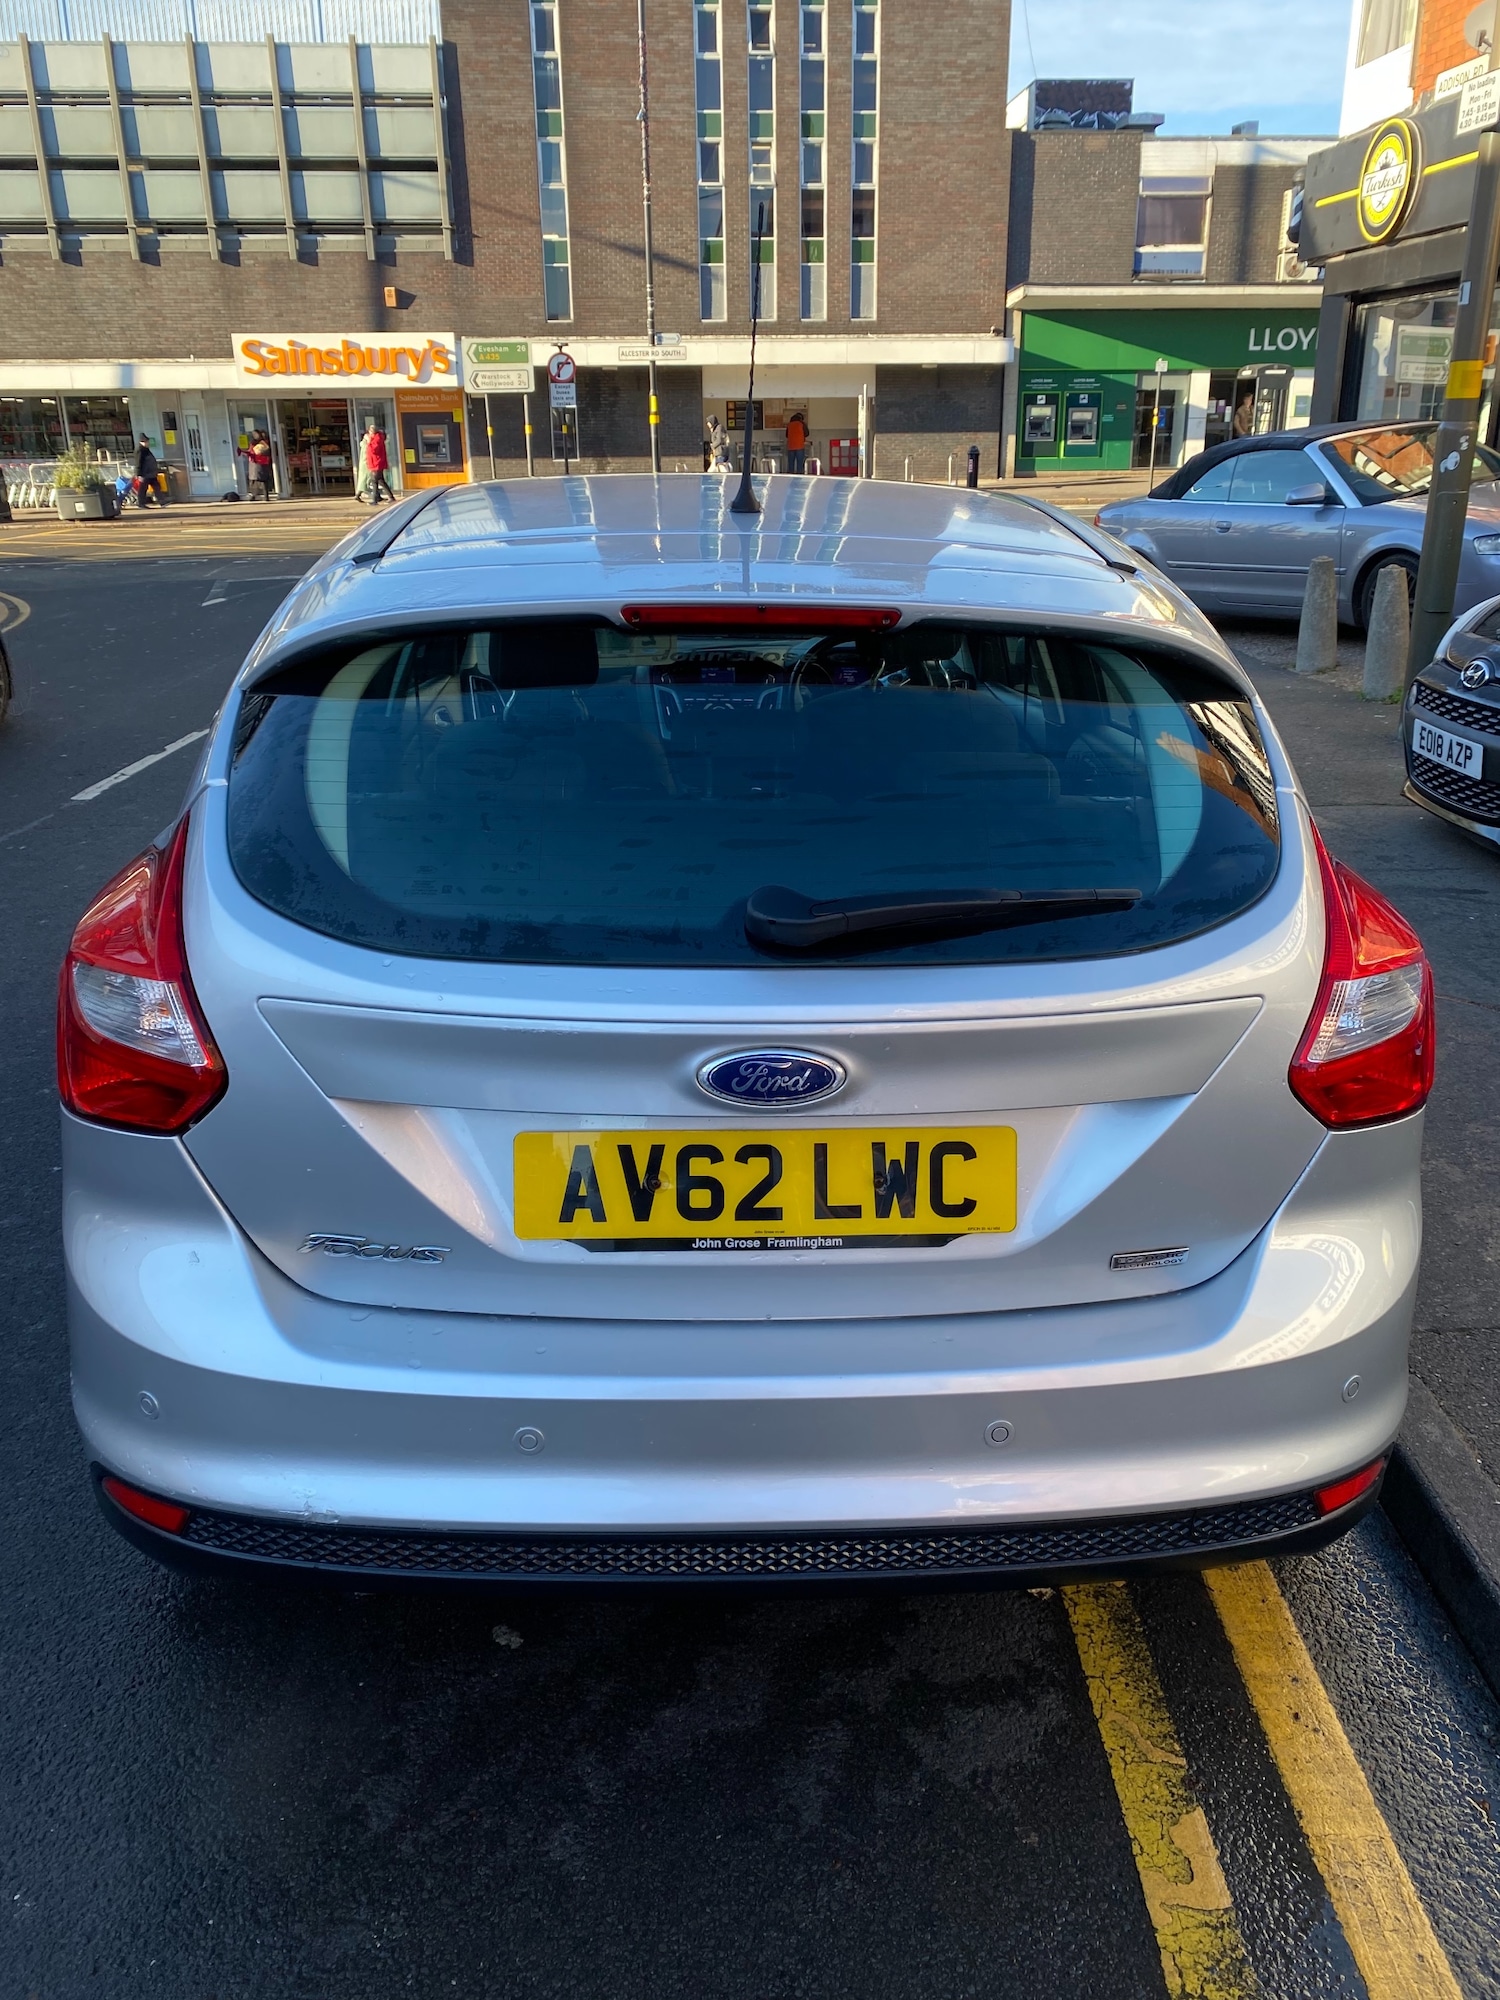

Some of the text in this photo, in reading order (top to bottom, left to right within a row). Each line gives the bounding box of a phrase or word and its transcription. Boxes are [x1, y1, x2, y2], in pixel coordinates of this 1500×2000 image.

[1438, 64, 1484, 92] ADDISON RD
[1468, 76, 1496, 92] No loading
[1366, 166, 1403, 194] Turkish
[1248, 327, 1320, 351] LLOY
[241, 339, 450, 381] Sainsbury's
[399, 394, 438, 402] Sainsbury's
[1419, 726, 1473, 770] EO18 AZP
[731, 1060, 812, 1094] Ford
[559, 1141, 978, 1223] AV62 LWC
[692, 1235, 843, 1250] John Grose Framlingham
